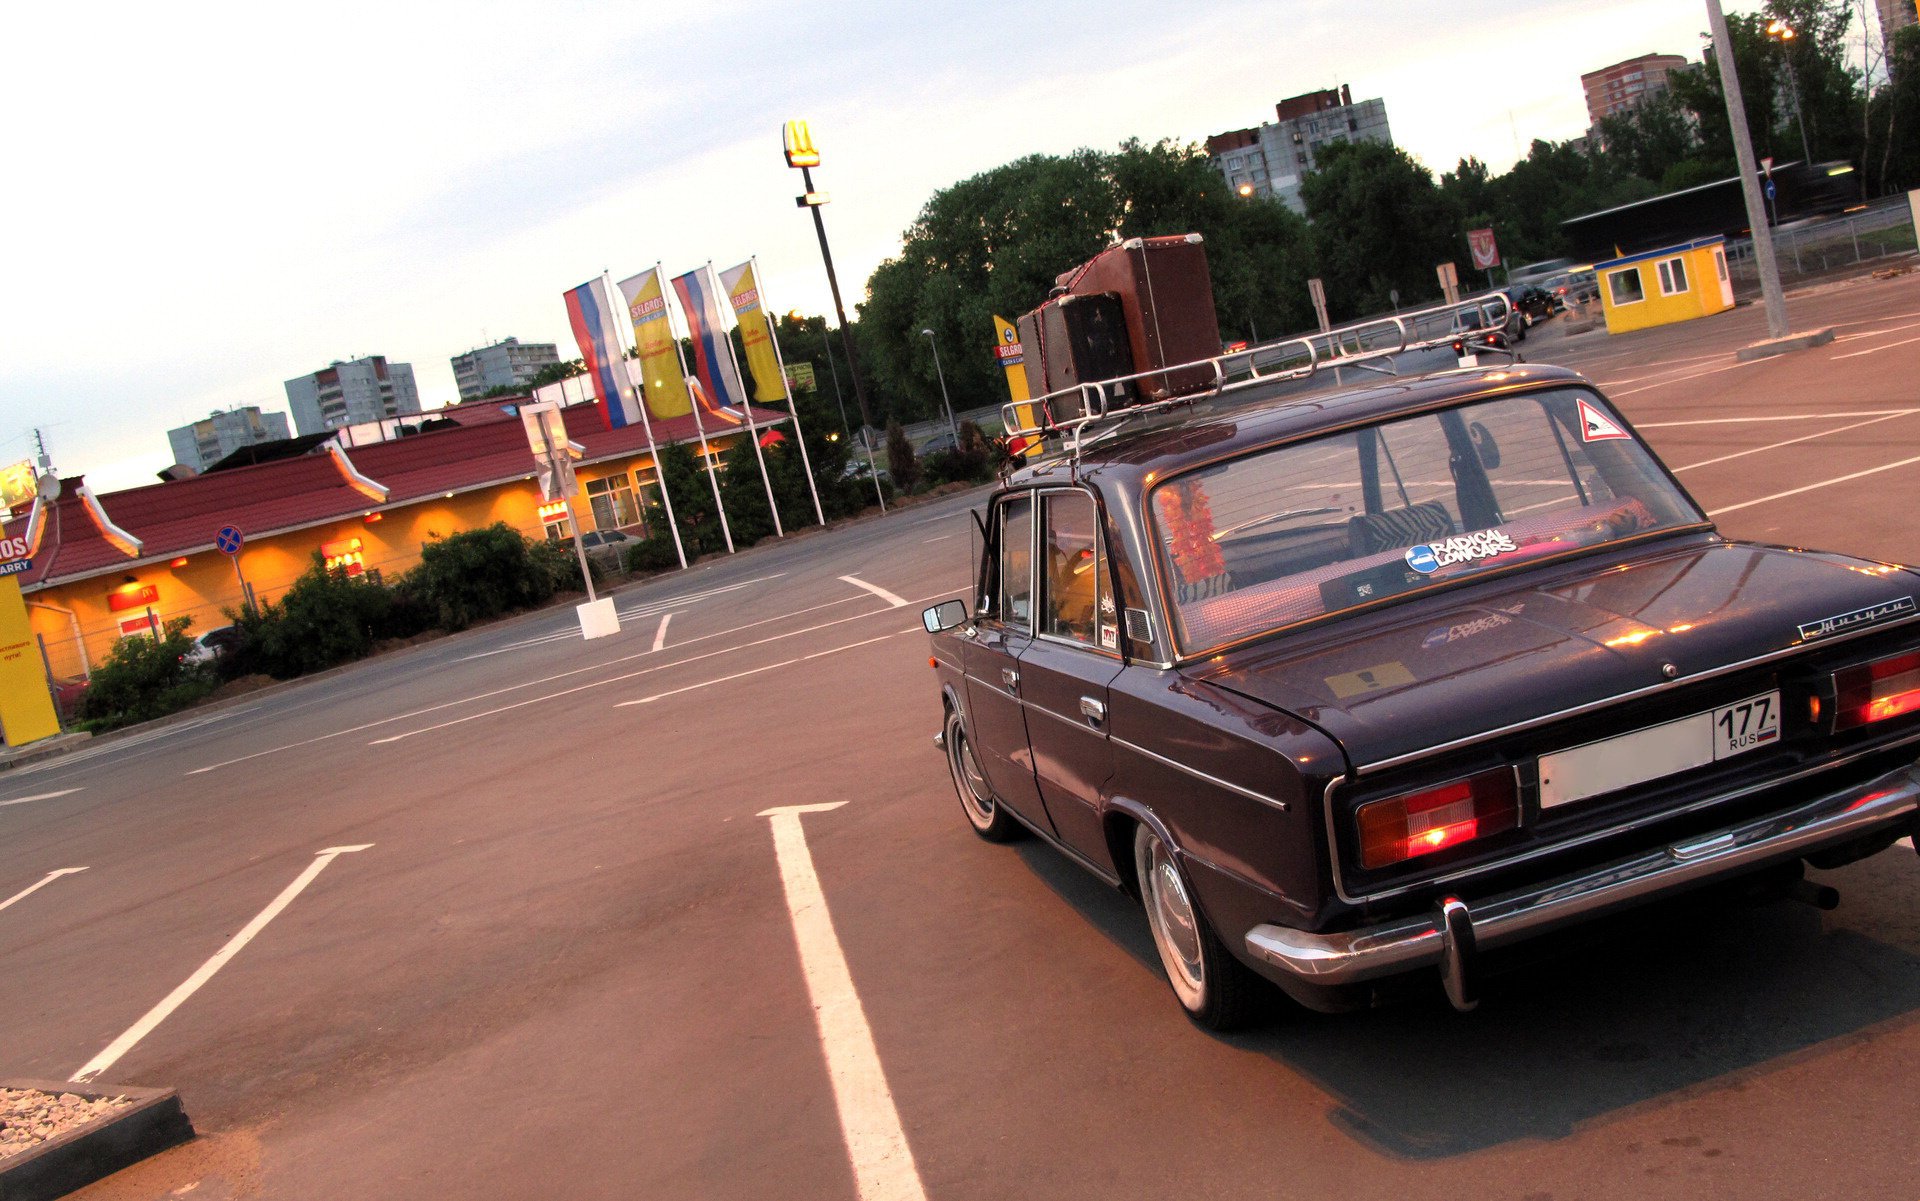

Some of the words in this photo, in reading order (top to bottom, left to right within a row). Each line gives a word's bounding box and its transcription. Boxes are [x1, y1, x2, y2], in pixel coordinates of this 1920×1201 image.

[631, 297, 664, 318] SELGROS
[731, 288, 757, 306] SELGROS
[1000, 344, 1022, 357] SELGRO
[0, 537, 27, 559] OS
[1428, 529, 1511, 556] RADICAL
[1433, 539, 1518, 567] LOWCARS
[0, 560, 29, 574] ARRY
[1805, 602, 1911, 637] Жигули
[1718, 697, 1771, 740] 177
[1729, 733, 1757, 751] RUS
